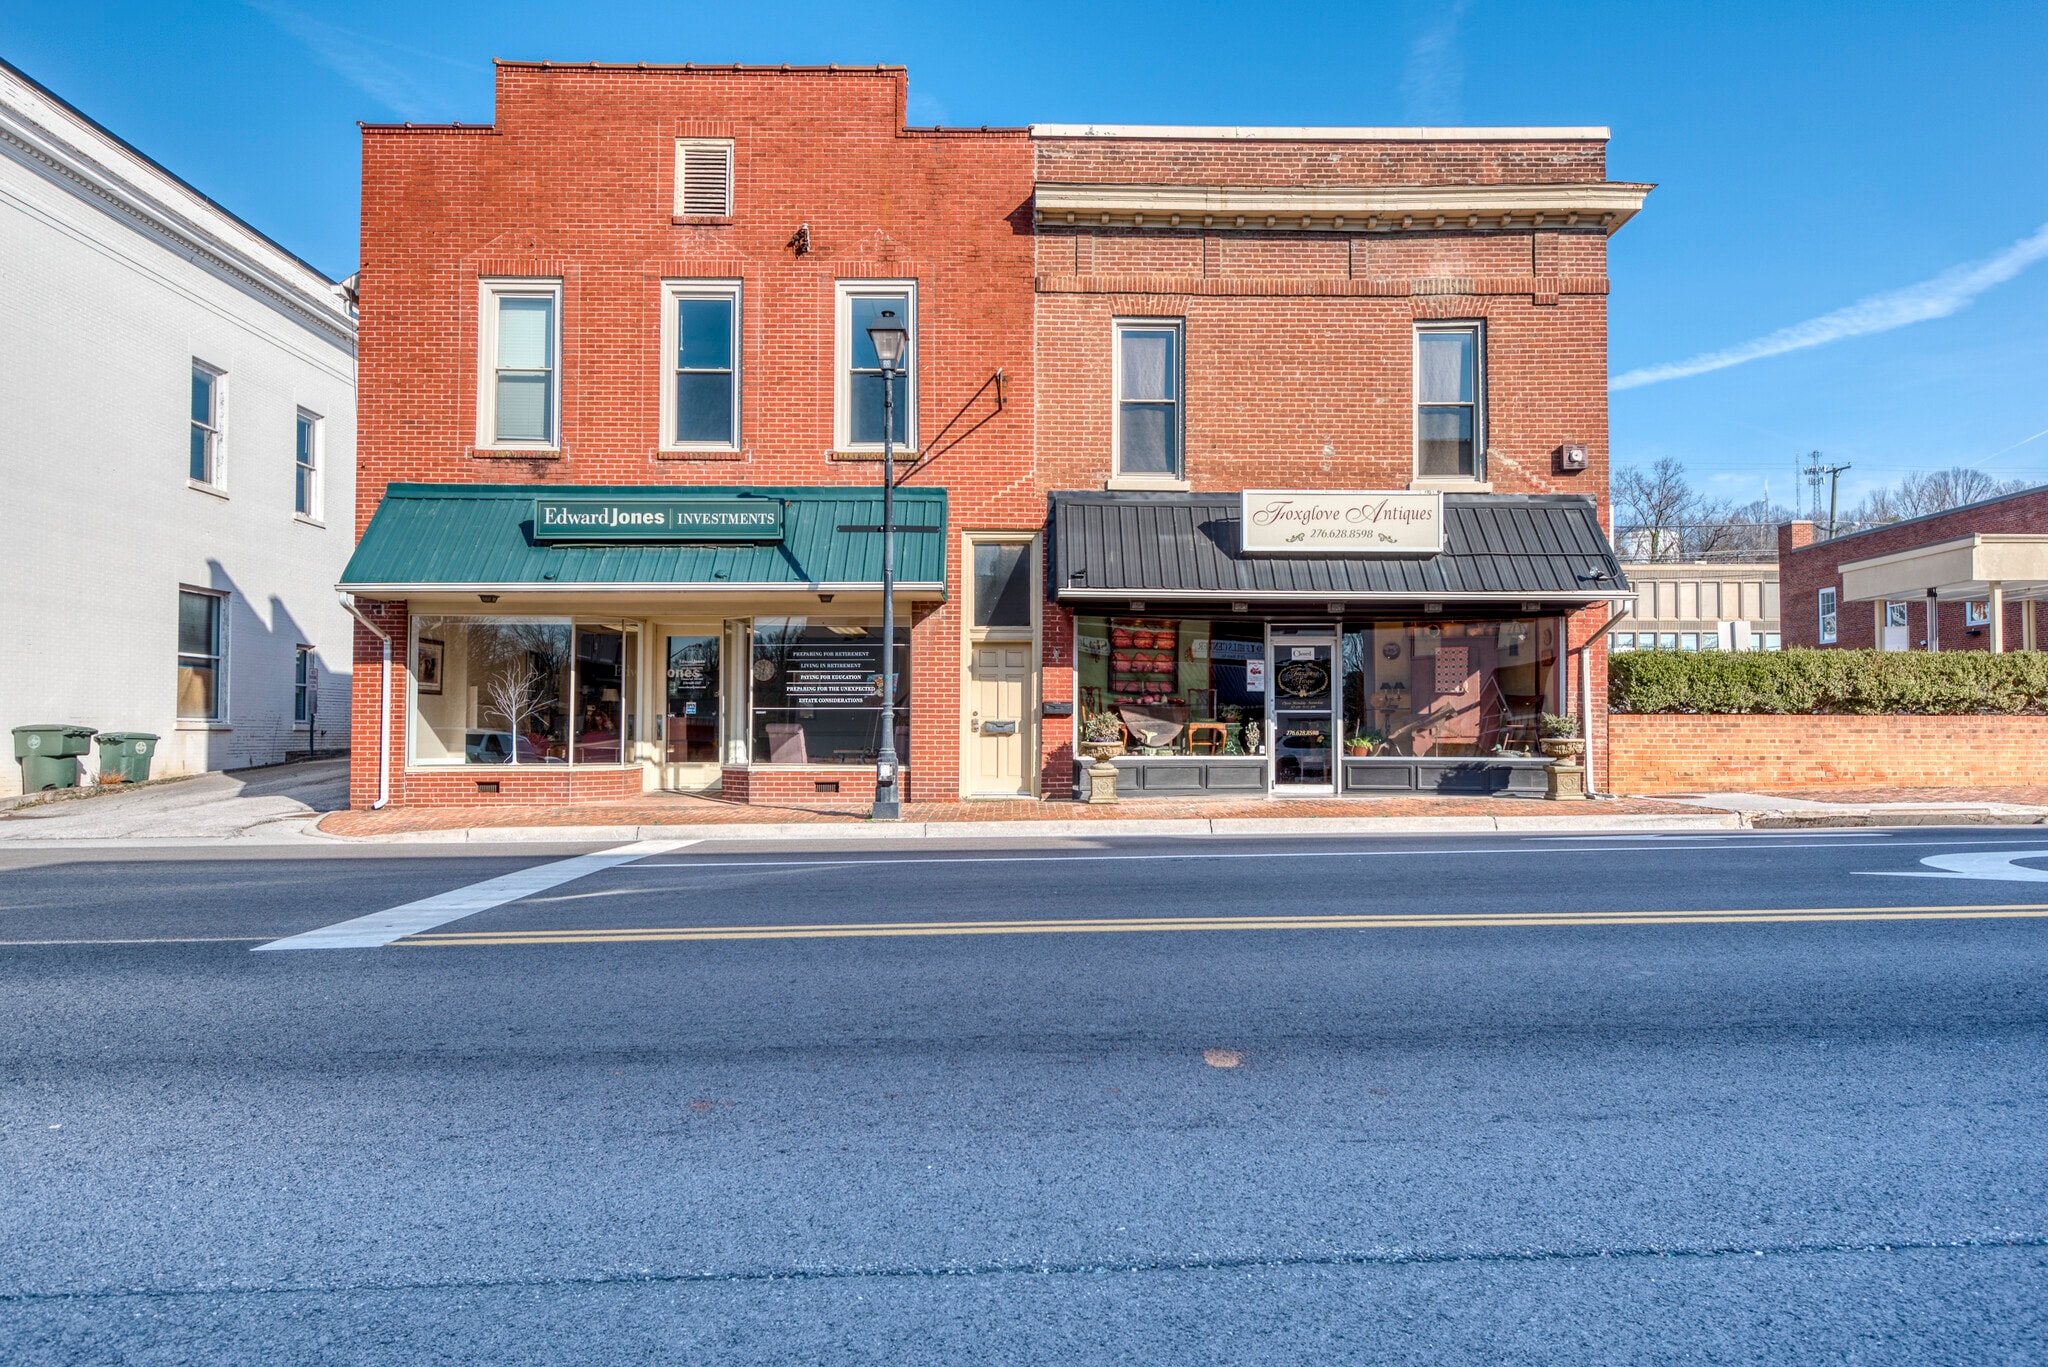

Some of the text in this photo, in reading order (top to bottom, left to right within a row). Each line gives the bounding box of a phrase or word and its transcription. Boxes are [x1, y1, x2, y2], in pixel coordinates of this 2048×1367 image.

[1252, 499, 1433, 526] Foxglove Antiques
[677, 513, 775, 525] INVESTMENTS
[1309, 528, 1374, 539] 276.628.8598
